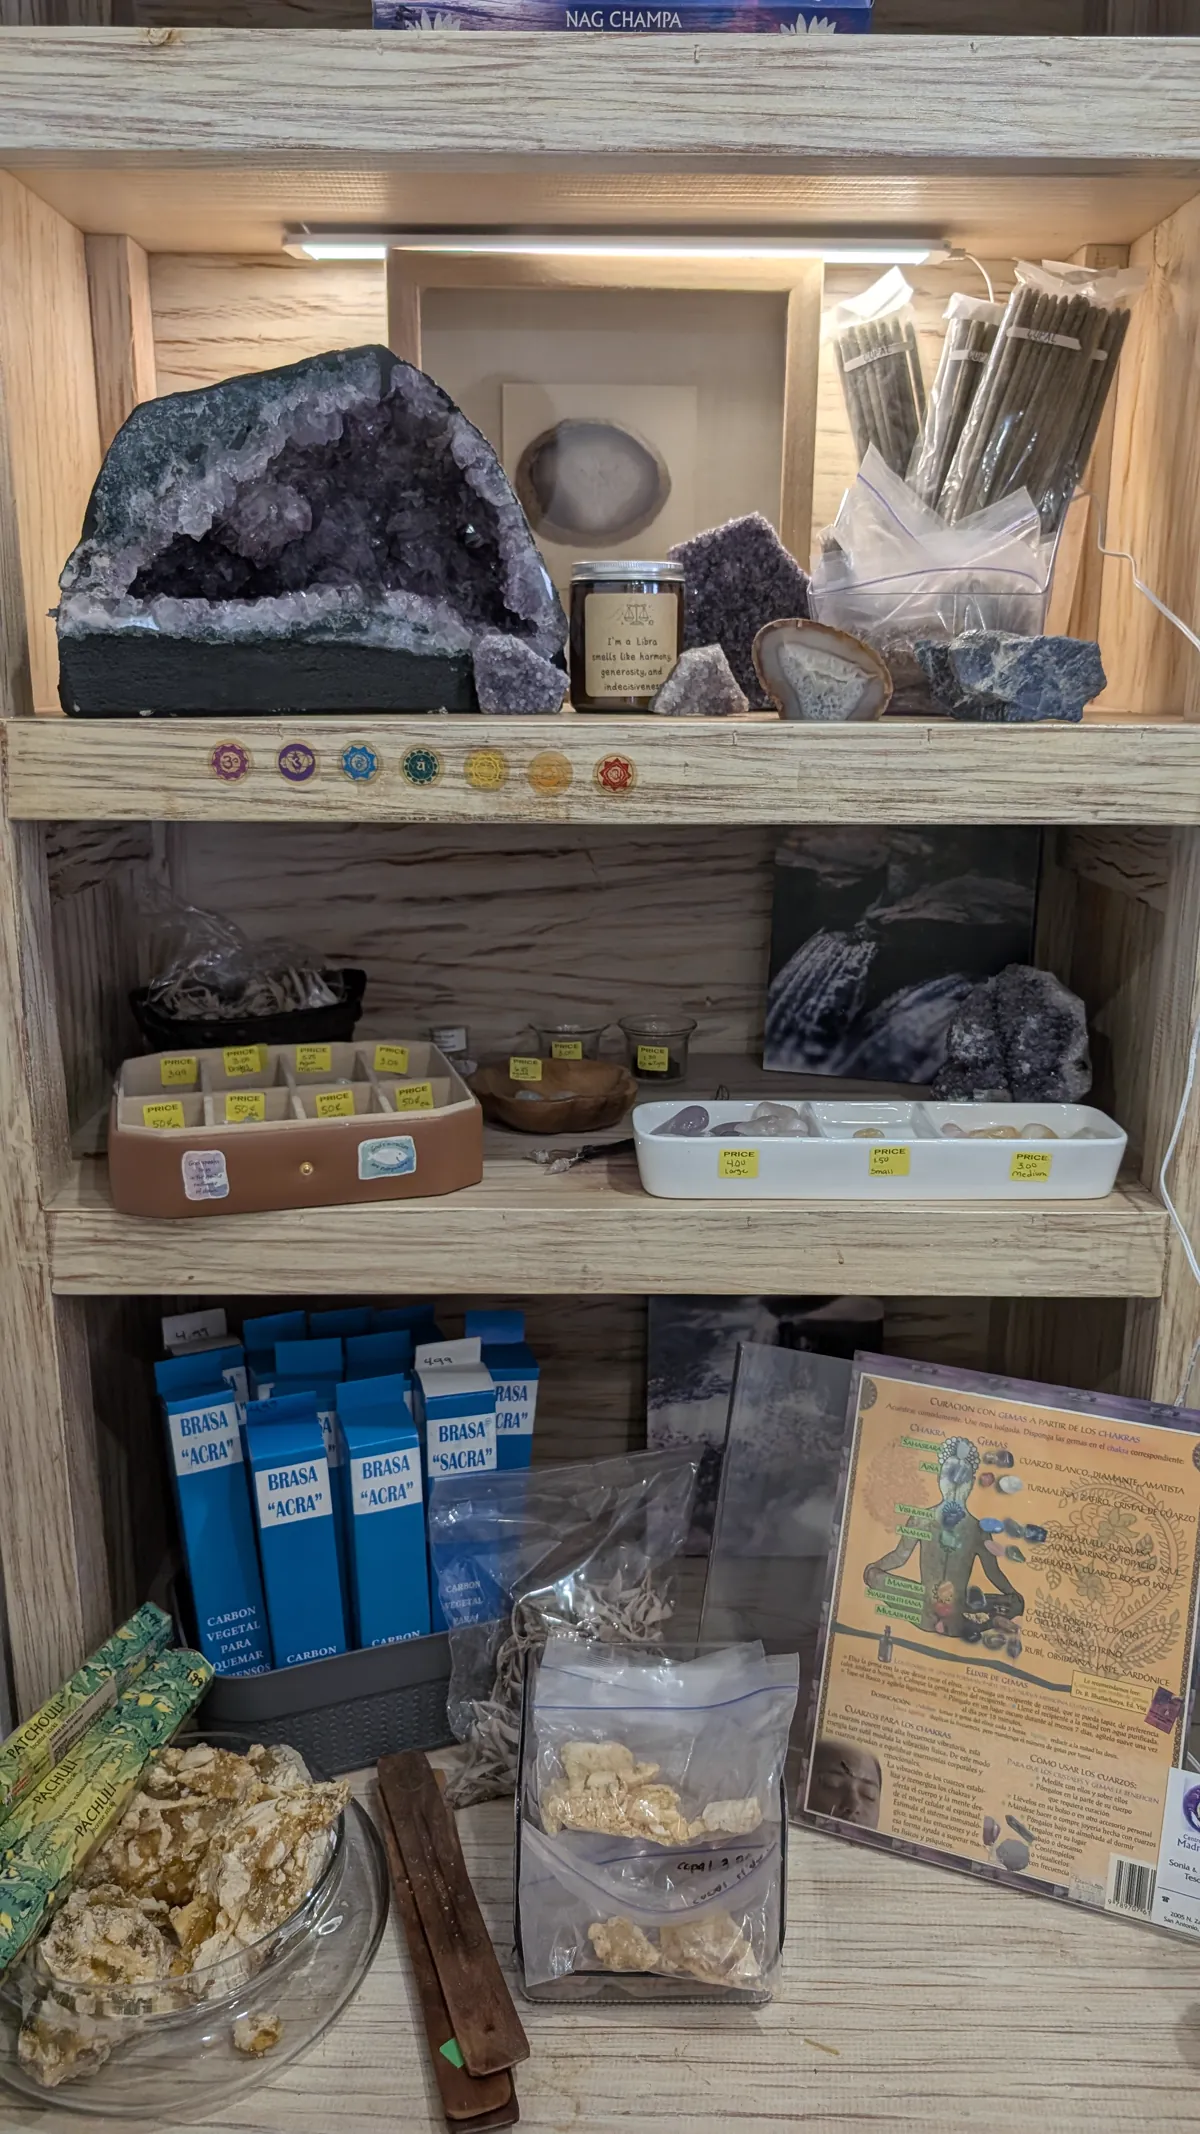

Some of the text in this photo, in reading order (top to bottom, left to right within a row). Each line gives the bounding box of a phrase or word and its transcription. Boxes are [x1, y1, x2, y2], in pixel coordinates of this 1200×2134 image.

[566, 10, 683, 29] NAG CHAMPA
[607, 637, 622, 646] I'm
[636, 637, 658, 646] Libra
[592, 653, 617, 662] smells
[620, 653, 636, 662] like
[648, 667, 663, 676] and
[604, 683, 660, 691] indecisivenes
[227, 1049, 255, 1057] PRICE
[379, 1046, 406, 1055] PRICE
[164, 1058, 193, 1066] PRICE
[513, 1058, 538, 1066] PRICE
[320, 1092, 349, 1102] PRICE
[399, 1085, 428, 1096] PRICE
[147, 1104, 179, 1113] PRICE
[234, 1104, 256, 1114] 50¢
[321, 1104, 342, 1115] 50¢
[402, 1095, 420, 1107] 50¢
[152, 1117, 173, 1128] 50¢
[1016, 1153, 1048, 1161] PRICE
[495, 1384, 528, 1402] RASA
[180, 1410, 229, 1437] BRASA
[929, 1396, 1141, 1444] CURACION CON GEMAS A PARTIR DE LOS CHAKRAS
[439, 1420, 486, 1443] BRASA
[909, 1422, 946, 1437] CHAKRA
[976, 1435, 1008, 1449] GEMAS
[978, 1420, 992, 1429] ropa
[1023, 1428, 1054, 1442] Disponga
[1055, 1434, 1064, 1442] las
[1065, 1437, 1087, 1448] gemas
[1106, 1443, 1128, 1454] chakra
[1130, 1448, 1184, 1466] correspondiente:
[362, 1454, 411, 1480] BRASA
[432, 1447, 493, 1472] “SACRA”
[267, 1465, 319, 1491] BRASA
[1019, 1457, 1185, 1495] CUARZO BLANCO, AMATISTA
[360, 1481, 414, 1507] “ACRA”
[267, 1492, 323, 1519] “ACRA”
[1159, 1509, 1196, 1523] CUARZO
[1082, 1565, 1139, 1585] CUARZO ROSA
[1119, 1557, 1180, 1576] TOPACIO AZUL
[445, 1580, 482, 1594] CARBON
[444, 1596, 484, 1610] VEGETAL
[207, 1606, 257, 1628] CARBON
[206, 1620, 261, 1643] VEGETAL
[1103, 1625, 1139, 1640] TOPACIO
[220, 1638, 252, 1655] PARA
[286, 1645, 338, 1664] CARBON
[213, 1650, 265, 1673] QUEMAR
[965, 1666, 988, 1679] ELIXIR
[990, 1674, 998, 1682] DE
[1001, 1676, 1028, 1689] GEMAS
[844, 1703, 879, 1720] CUARZOS
[880, 1714, 899, 1725] PARA
[901, 1720, 914, 1729] LOS
[915, 1723, 951, 1739] CHAKRAS
[6, 1701, 66, 1759] PATCHOULI
[1029, 1753, 1137, 1789] COMO USAR LOS CUARZOS:
[1041, 1776, 1063, 1787] Medite
[1076, 1785, 1090, 1794] ellos
[1096, 1790, 1112, 1800] sobre
[1113, 1795, 1128, 1804] ellos
[1079, 1795, 1094, 1805] parte
[1111, 1804, 1132, 1816] cuerpo
[1054, 1805, 1070, 1815] bolso
[1085, 1813, 1097, 1822] otro
[1098, 1816, 1125, 1830] accesorio
[1126, 1824, 1152, 1839] personal
[1058, 1816, 1156, 1847] compre hecha con cuarzos
[1113, 1839, 1134, 1850] dormir
[1168, 1859, 1190, 1872] Sonia
[1163, 1916, 1174, 1924] San
[1170, 1911, 1185, 1921] 2005
